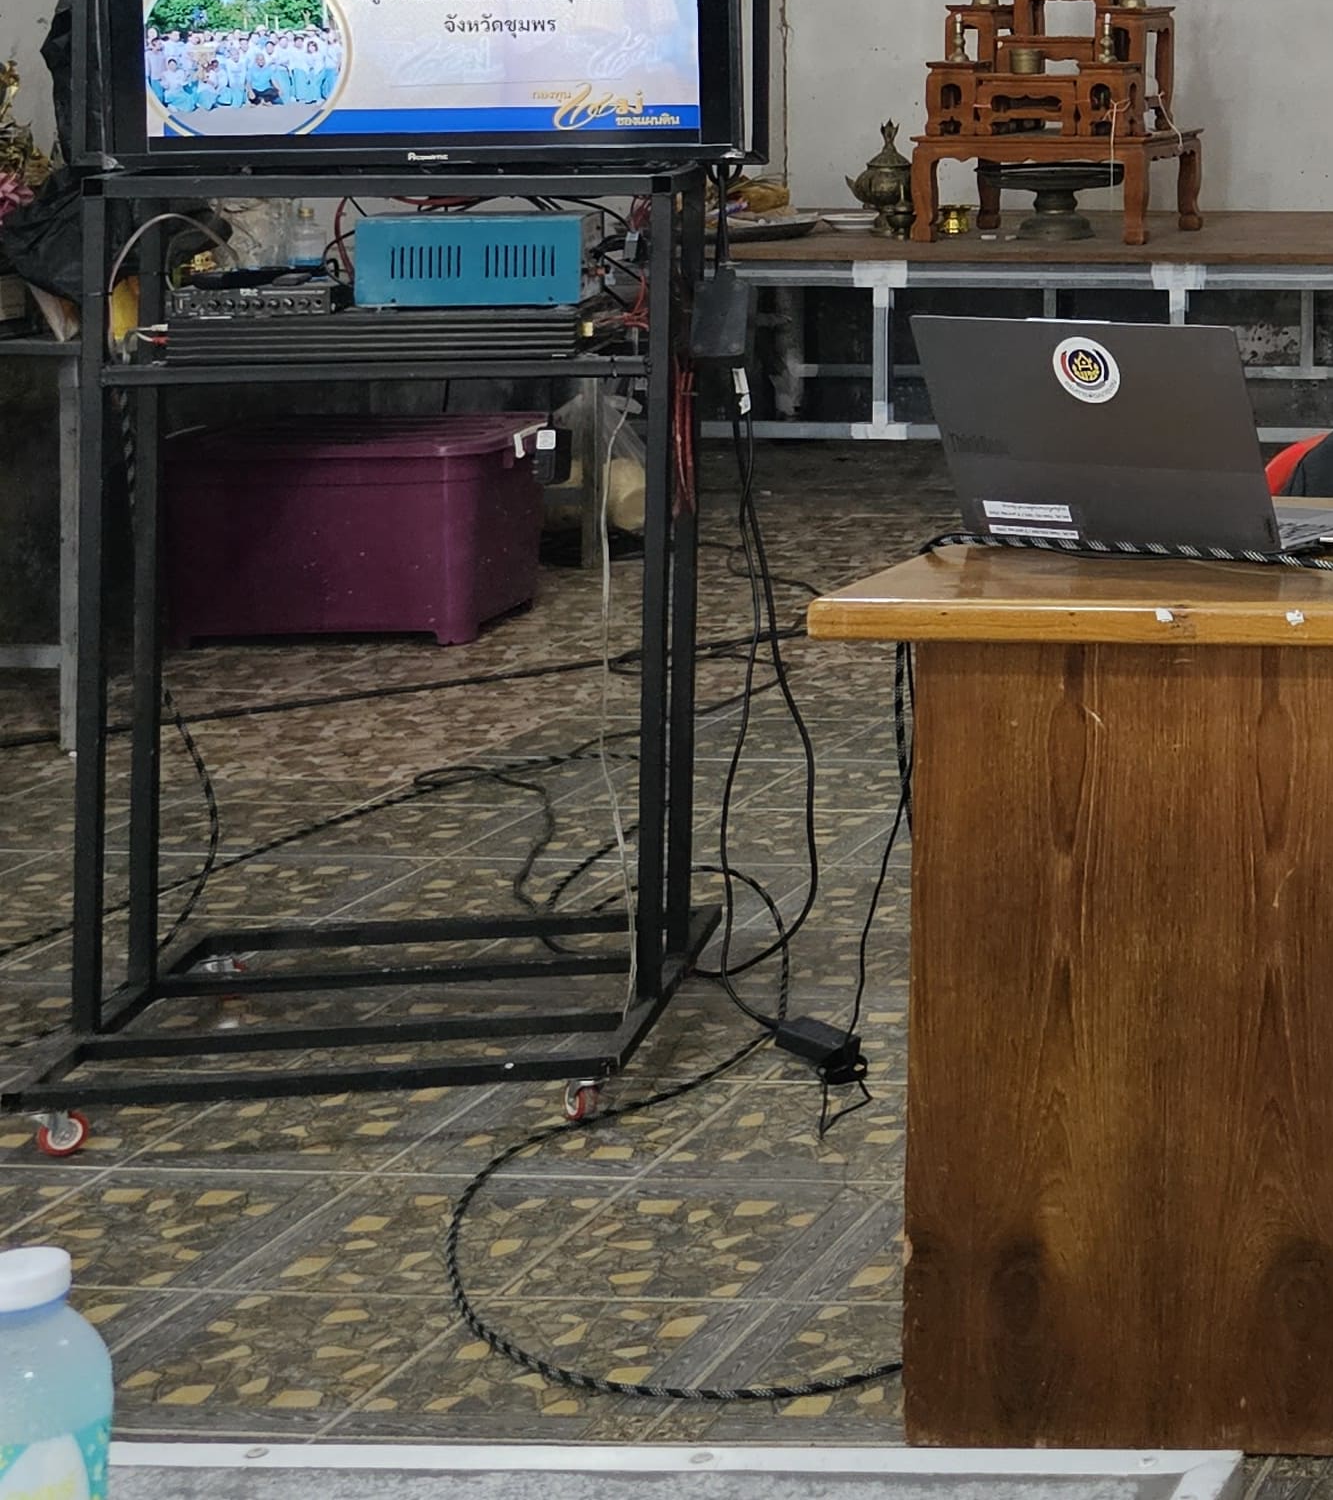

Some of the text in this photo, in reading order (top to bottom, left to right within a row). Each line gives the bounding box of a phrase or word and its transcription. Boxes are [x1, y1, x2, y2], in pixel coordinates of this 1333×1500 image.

[443, 14, 557, 38] จังหวัดชุมพร
